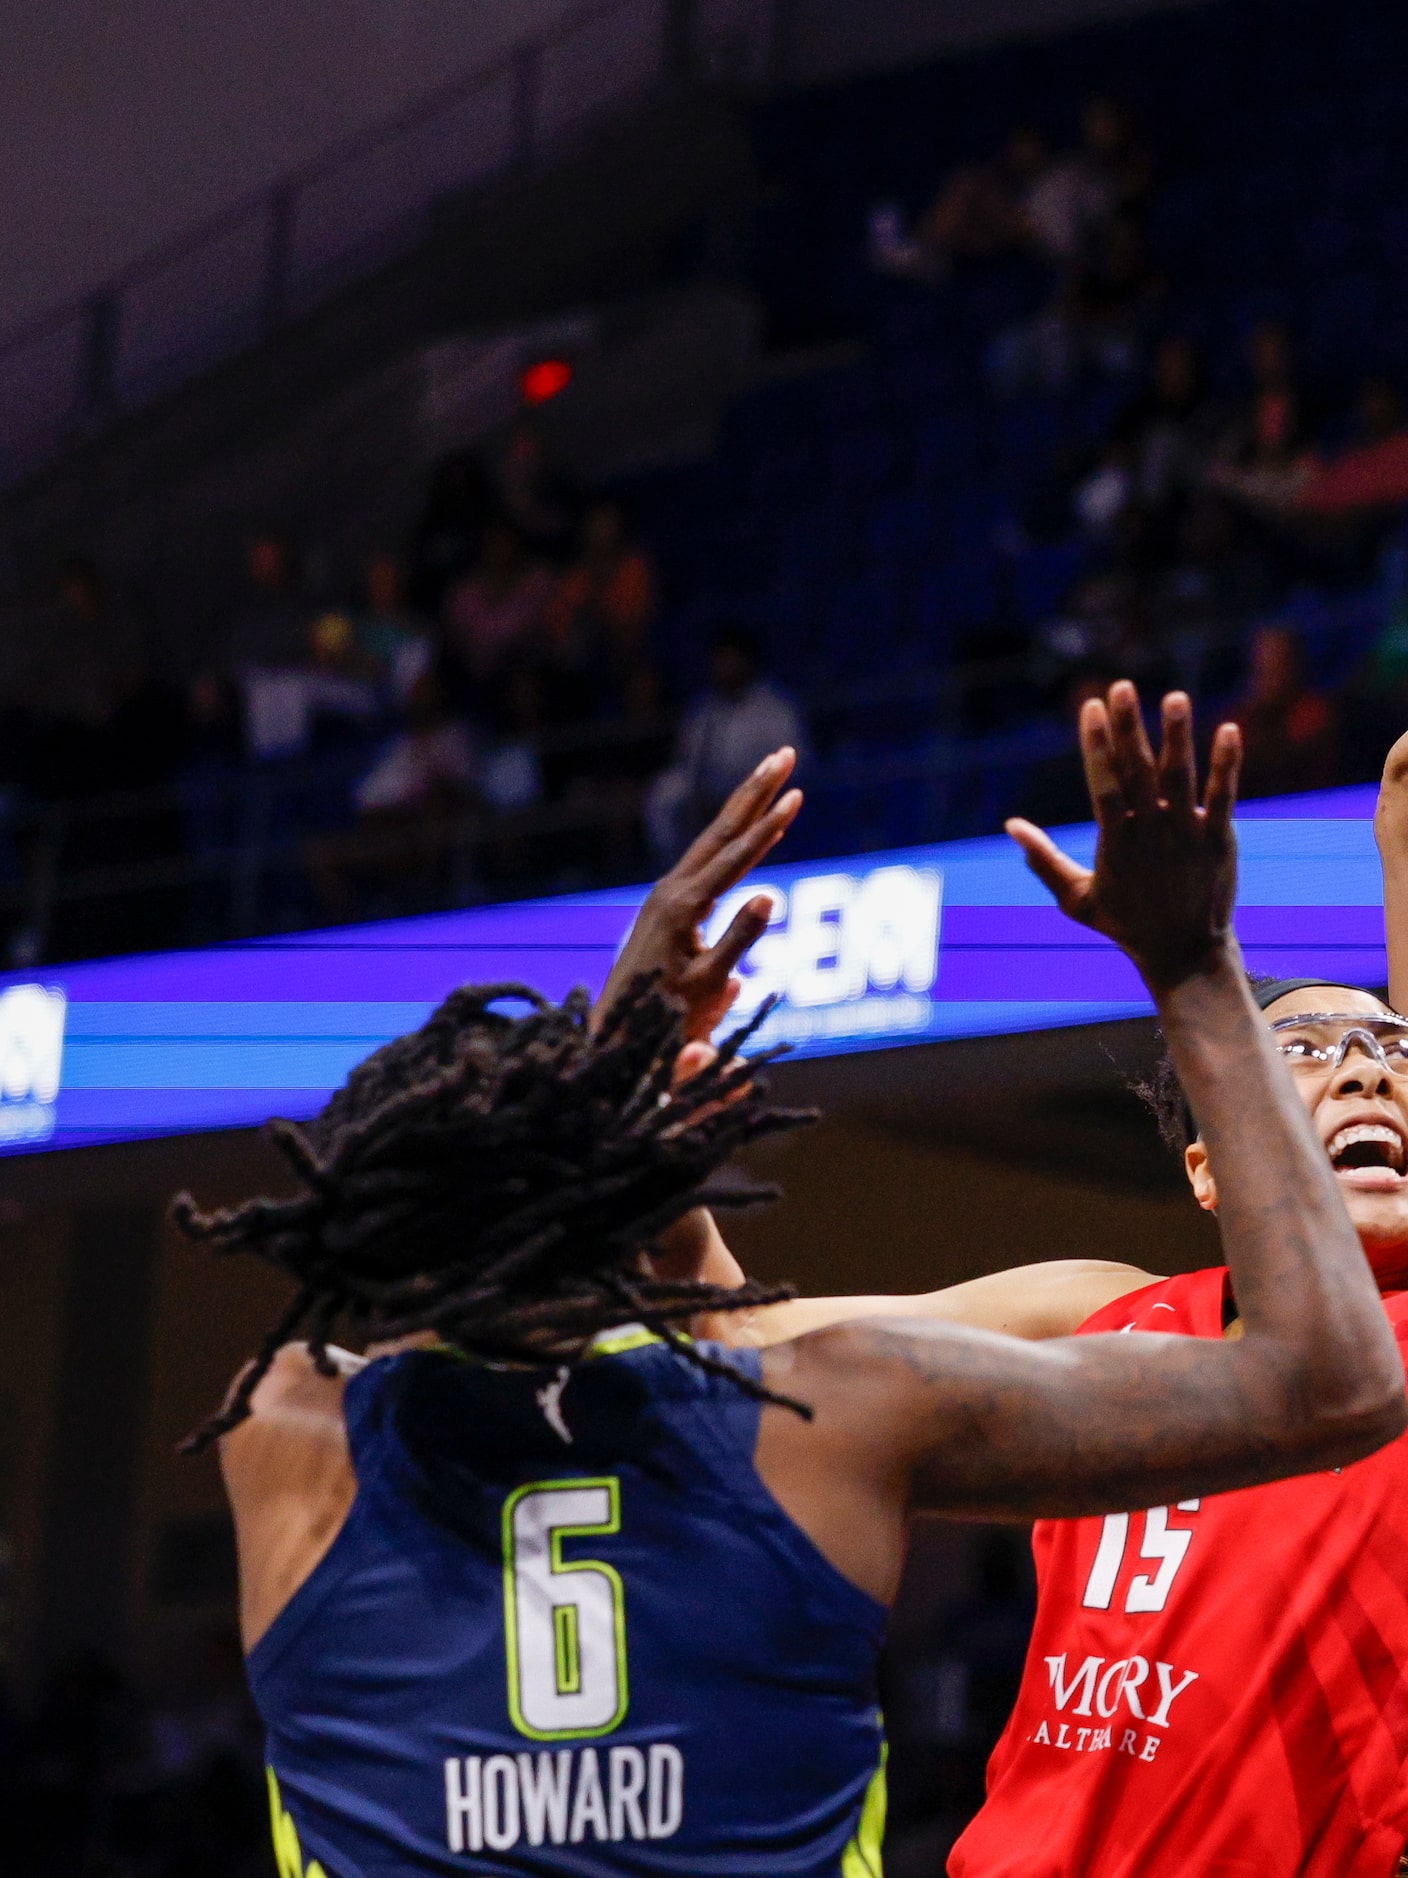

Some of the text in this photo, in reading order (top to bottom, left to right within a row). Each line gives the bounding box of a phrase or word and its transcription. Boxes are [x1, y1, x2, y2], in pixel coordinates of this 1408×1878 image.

[503, 1476, 629, 1741] 6
[1082, 1499, 1200, 1615] 15
[445, 1744, 683, 1852] HOWARD
